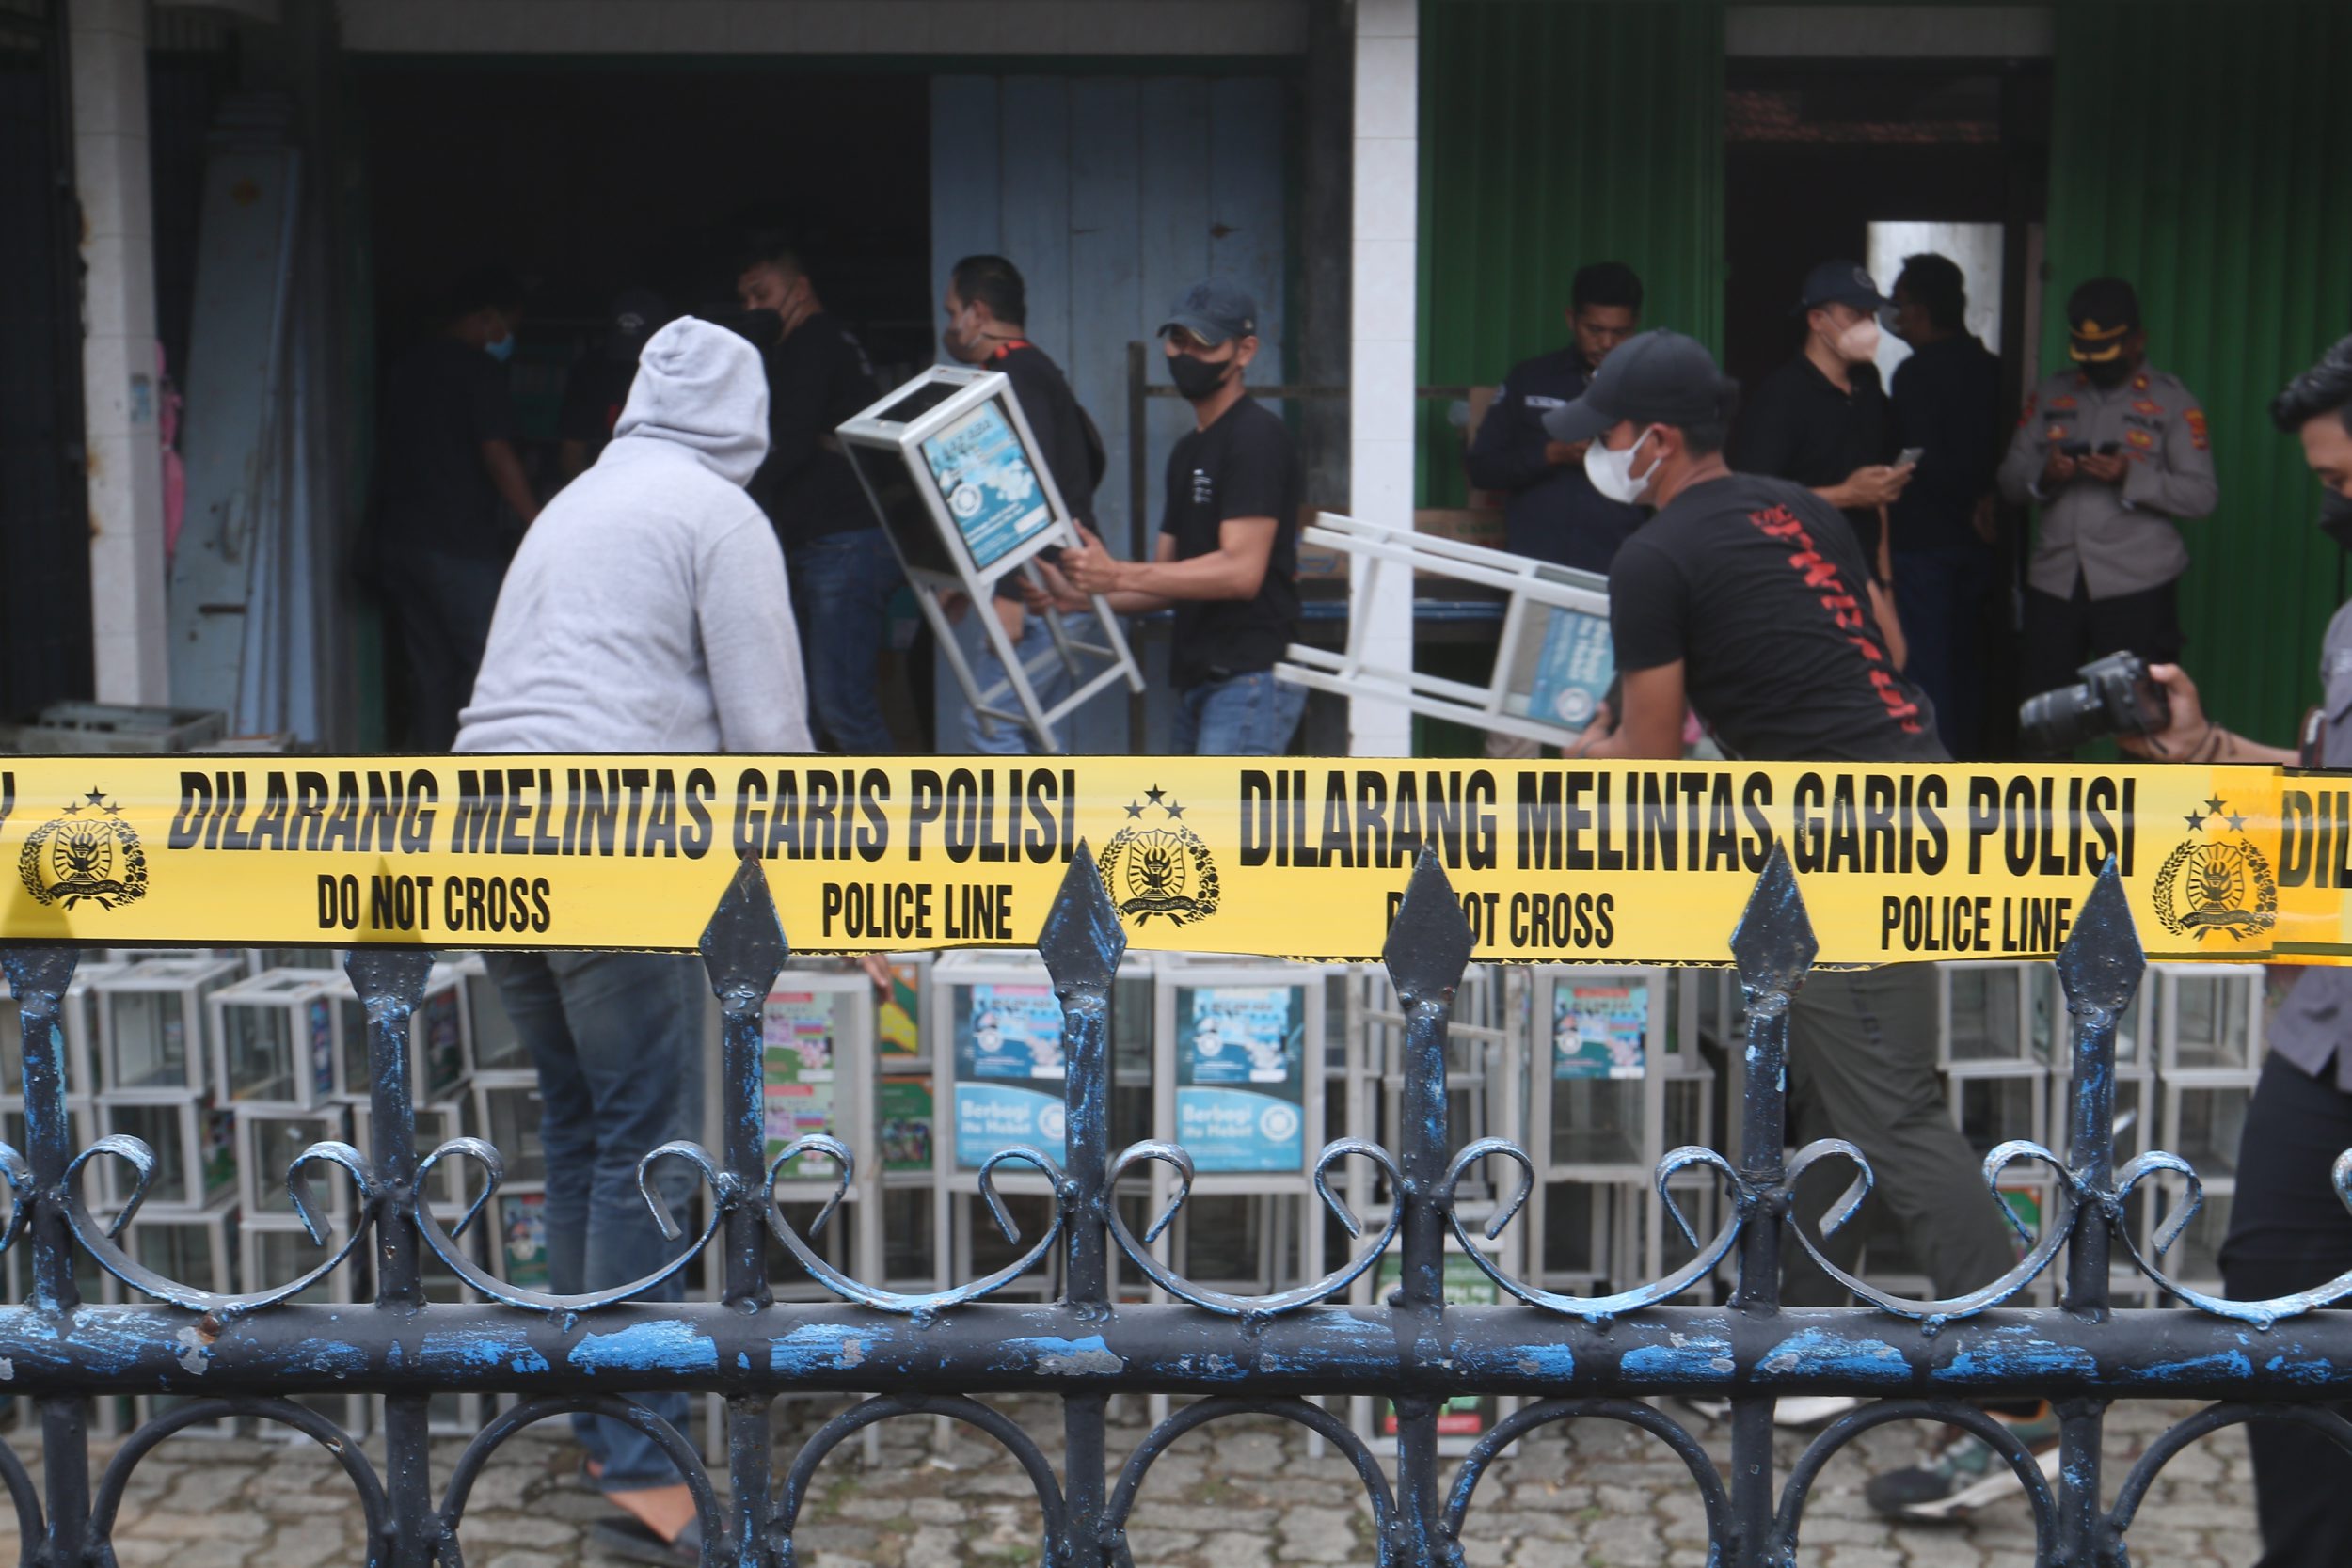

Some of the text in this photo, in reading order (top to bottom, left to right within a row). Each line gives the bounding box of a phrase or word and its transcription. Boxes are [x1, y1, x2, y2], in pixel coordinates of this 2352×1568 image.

[167, 768, 1076, 864] DILARANG MELINTAS GARIS POLISI
[1240, 769, 2136, 879] DILARANG MELINTAS GARIS POLISI
[317, 874, 551, 933] DO NOT CROSS
[822, 882, 1013, 939] POLICE LINE
[1457, 892, 1500, 946] OT
[1510, 892, 1614, 948] CROSS
[1882, 895, 2072, 952] POLICE LINE
